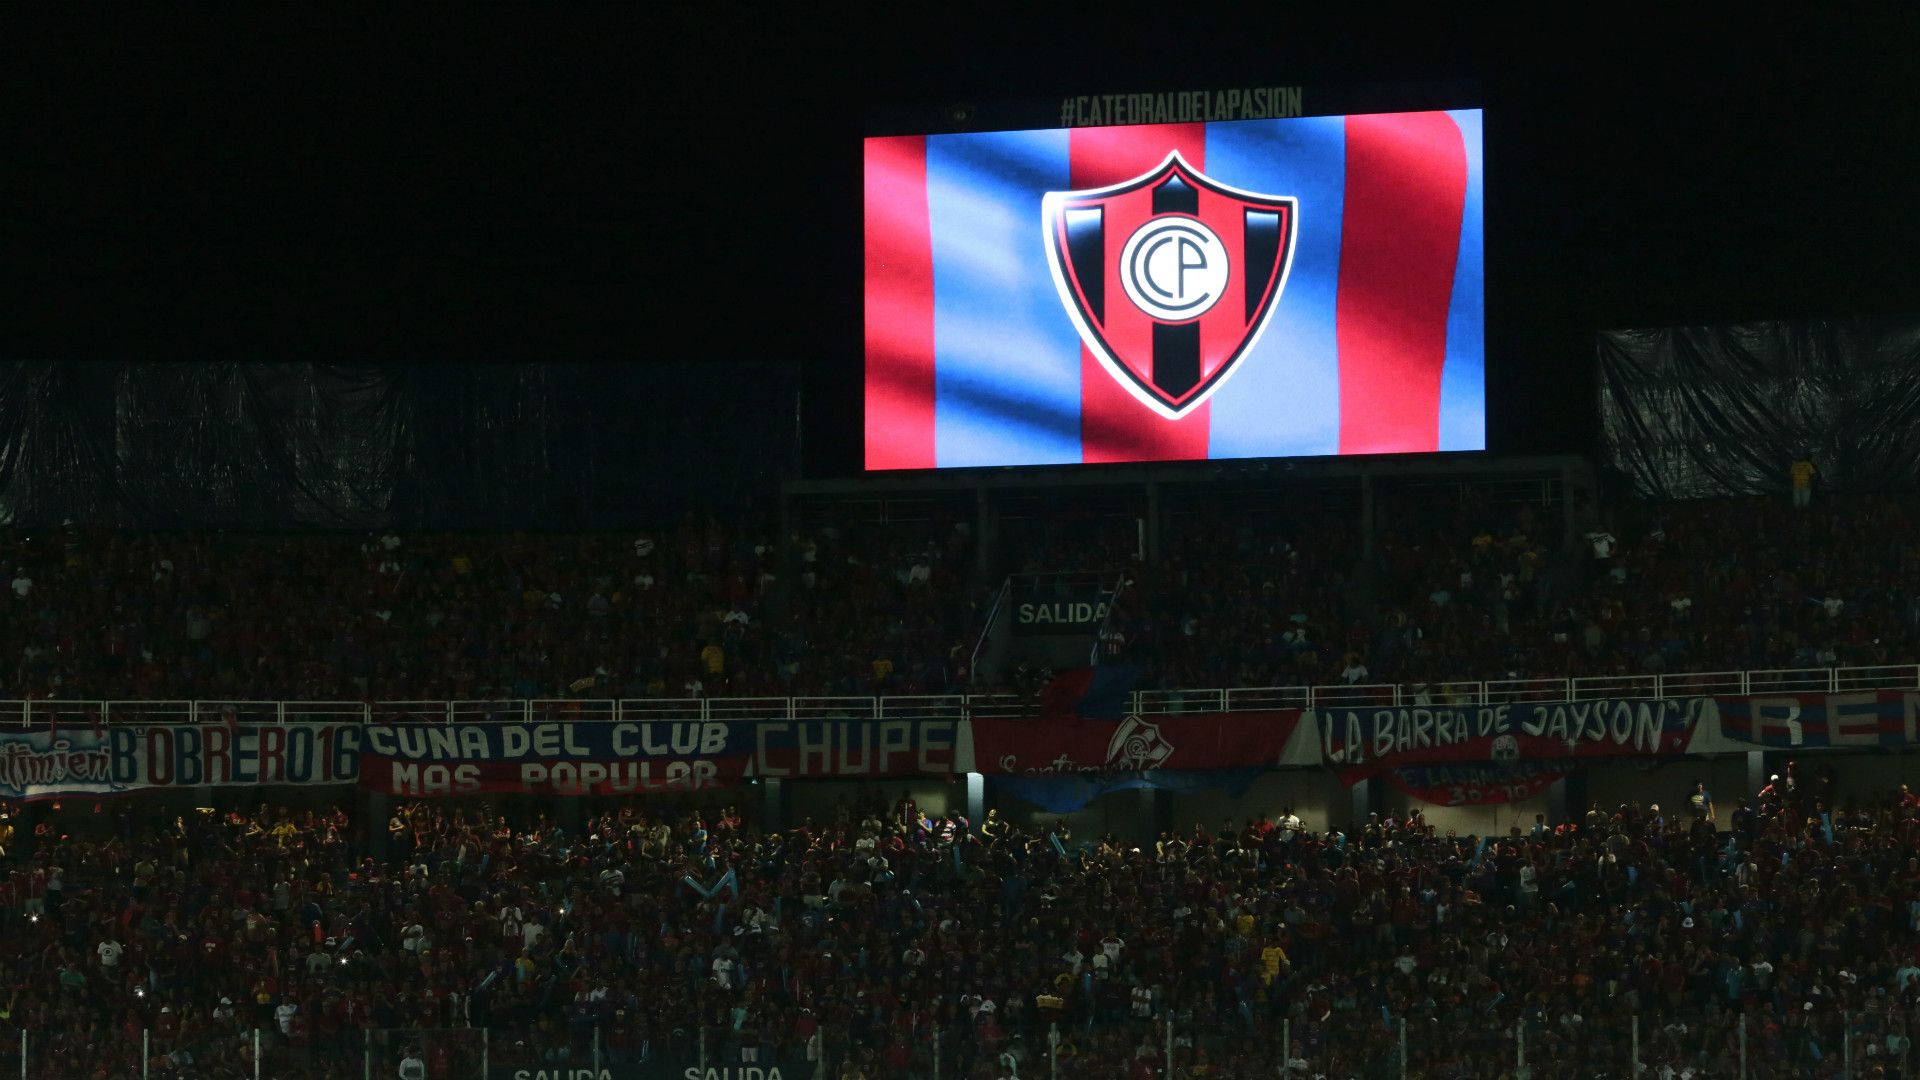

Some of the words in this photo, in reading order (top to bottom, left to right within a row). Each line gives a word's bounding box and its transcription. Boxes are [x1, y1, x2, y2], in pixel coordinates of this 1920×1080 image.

[1061, 86, 1303, 127] #CATEDRALDELAPASION
[1018, 602, 1106, 624] SALIDA
[367, 725, 490, 760] CUNA
[501, 723, 590, 758] DEL
[612, 722, 730, 757] CLUB
[756, 721, 952, 776] CHUPE
[1325, 712, 1364, 765] LA
[1372, 707, 1468, 758] BARRA
[1476, 704, 1511, 737] DE
[391, 760, 482, 795] MAS
[520, 759, 719, 794] POPULAR
